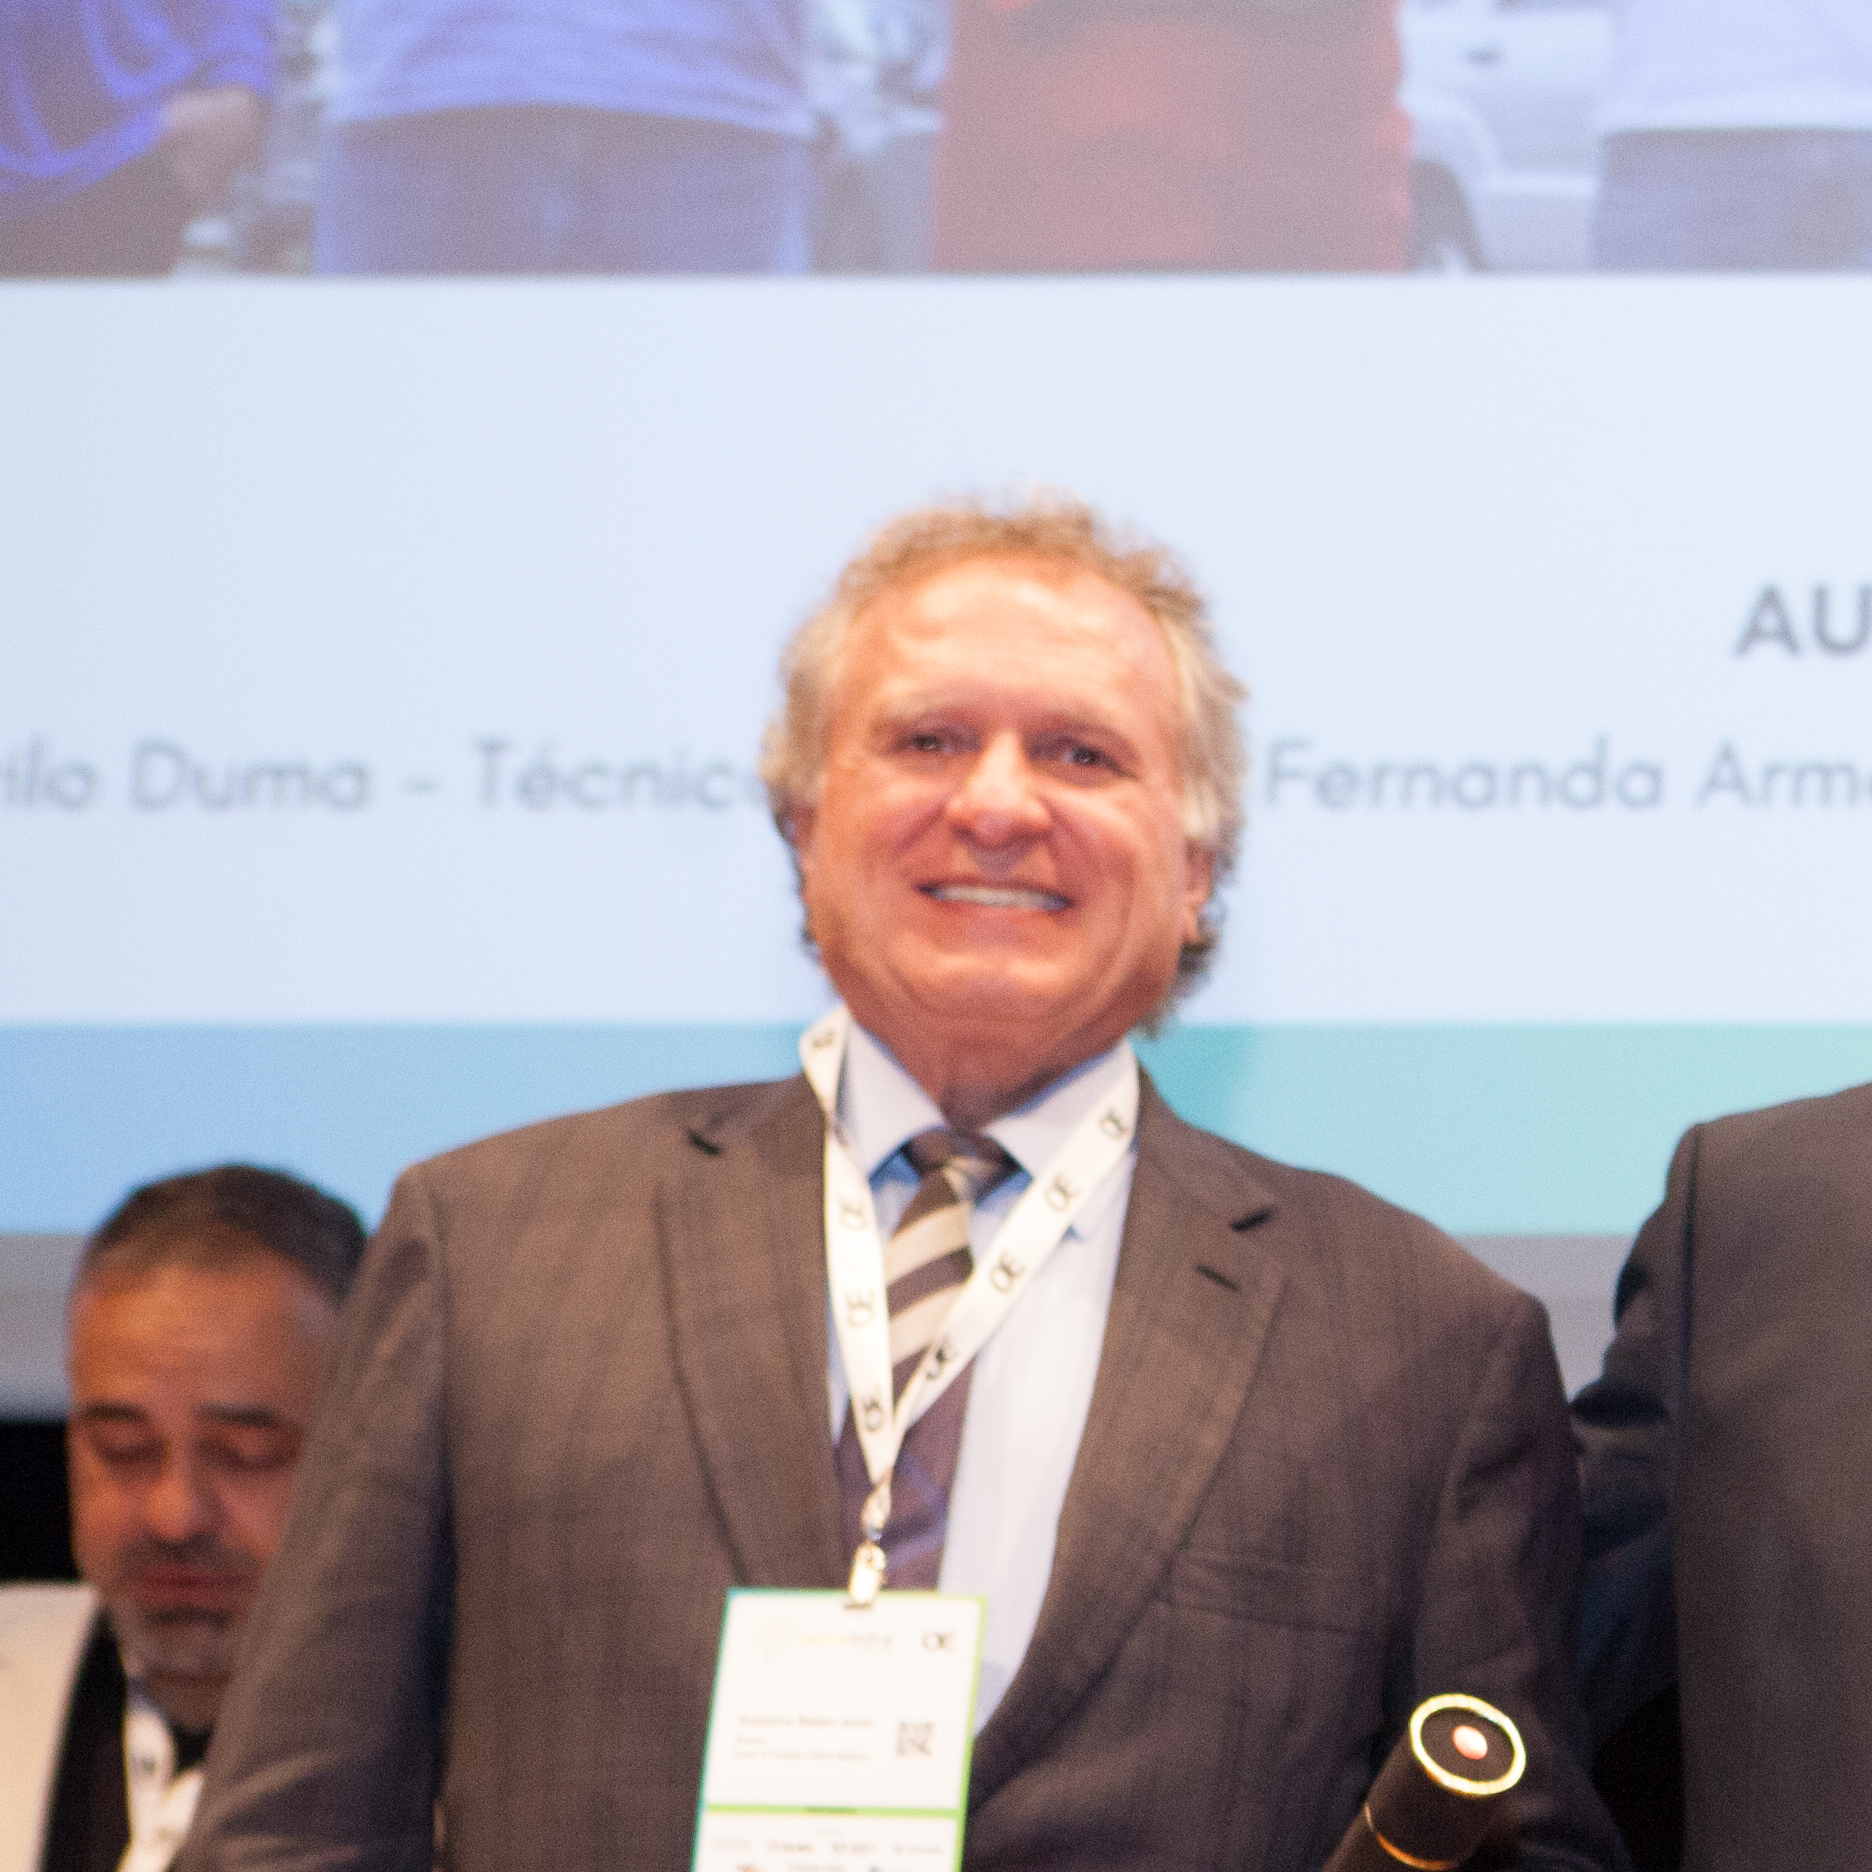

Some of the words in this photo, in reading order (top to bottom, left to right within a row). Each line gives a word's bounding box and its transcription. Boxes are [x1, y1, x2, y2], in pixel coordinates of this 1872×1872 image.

[0, 733, 100, 812] ilo
[130, 735, 371, 812] Duma
[1265, 732, 1664, 811] Fernanda
